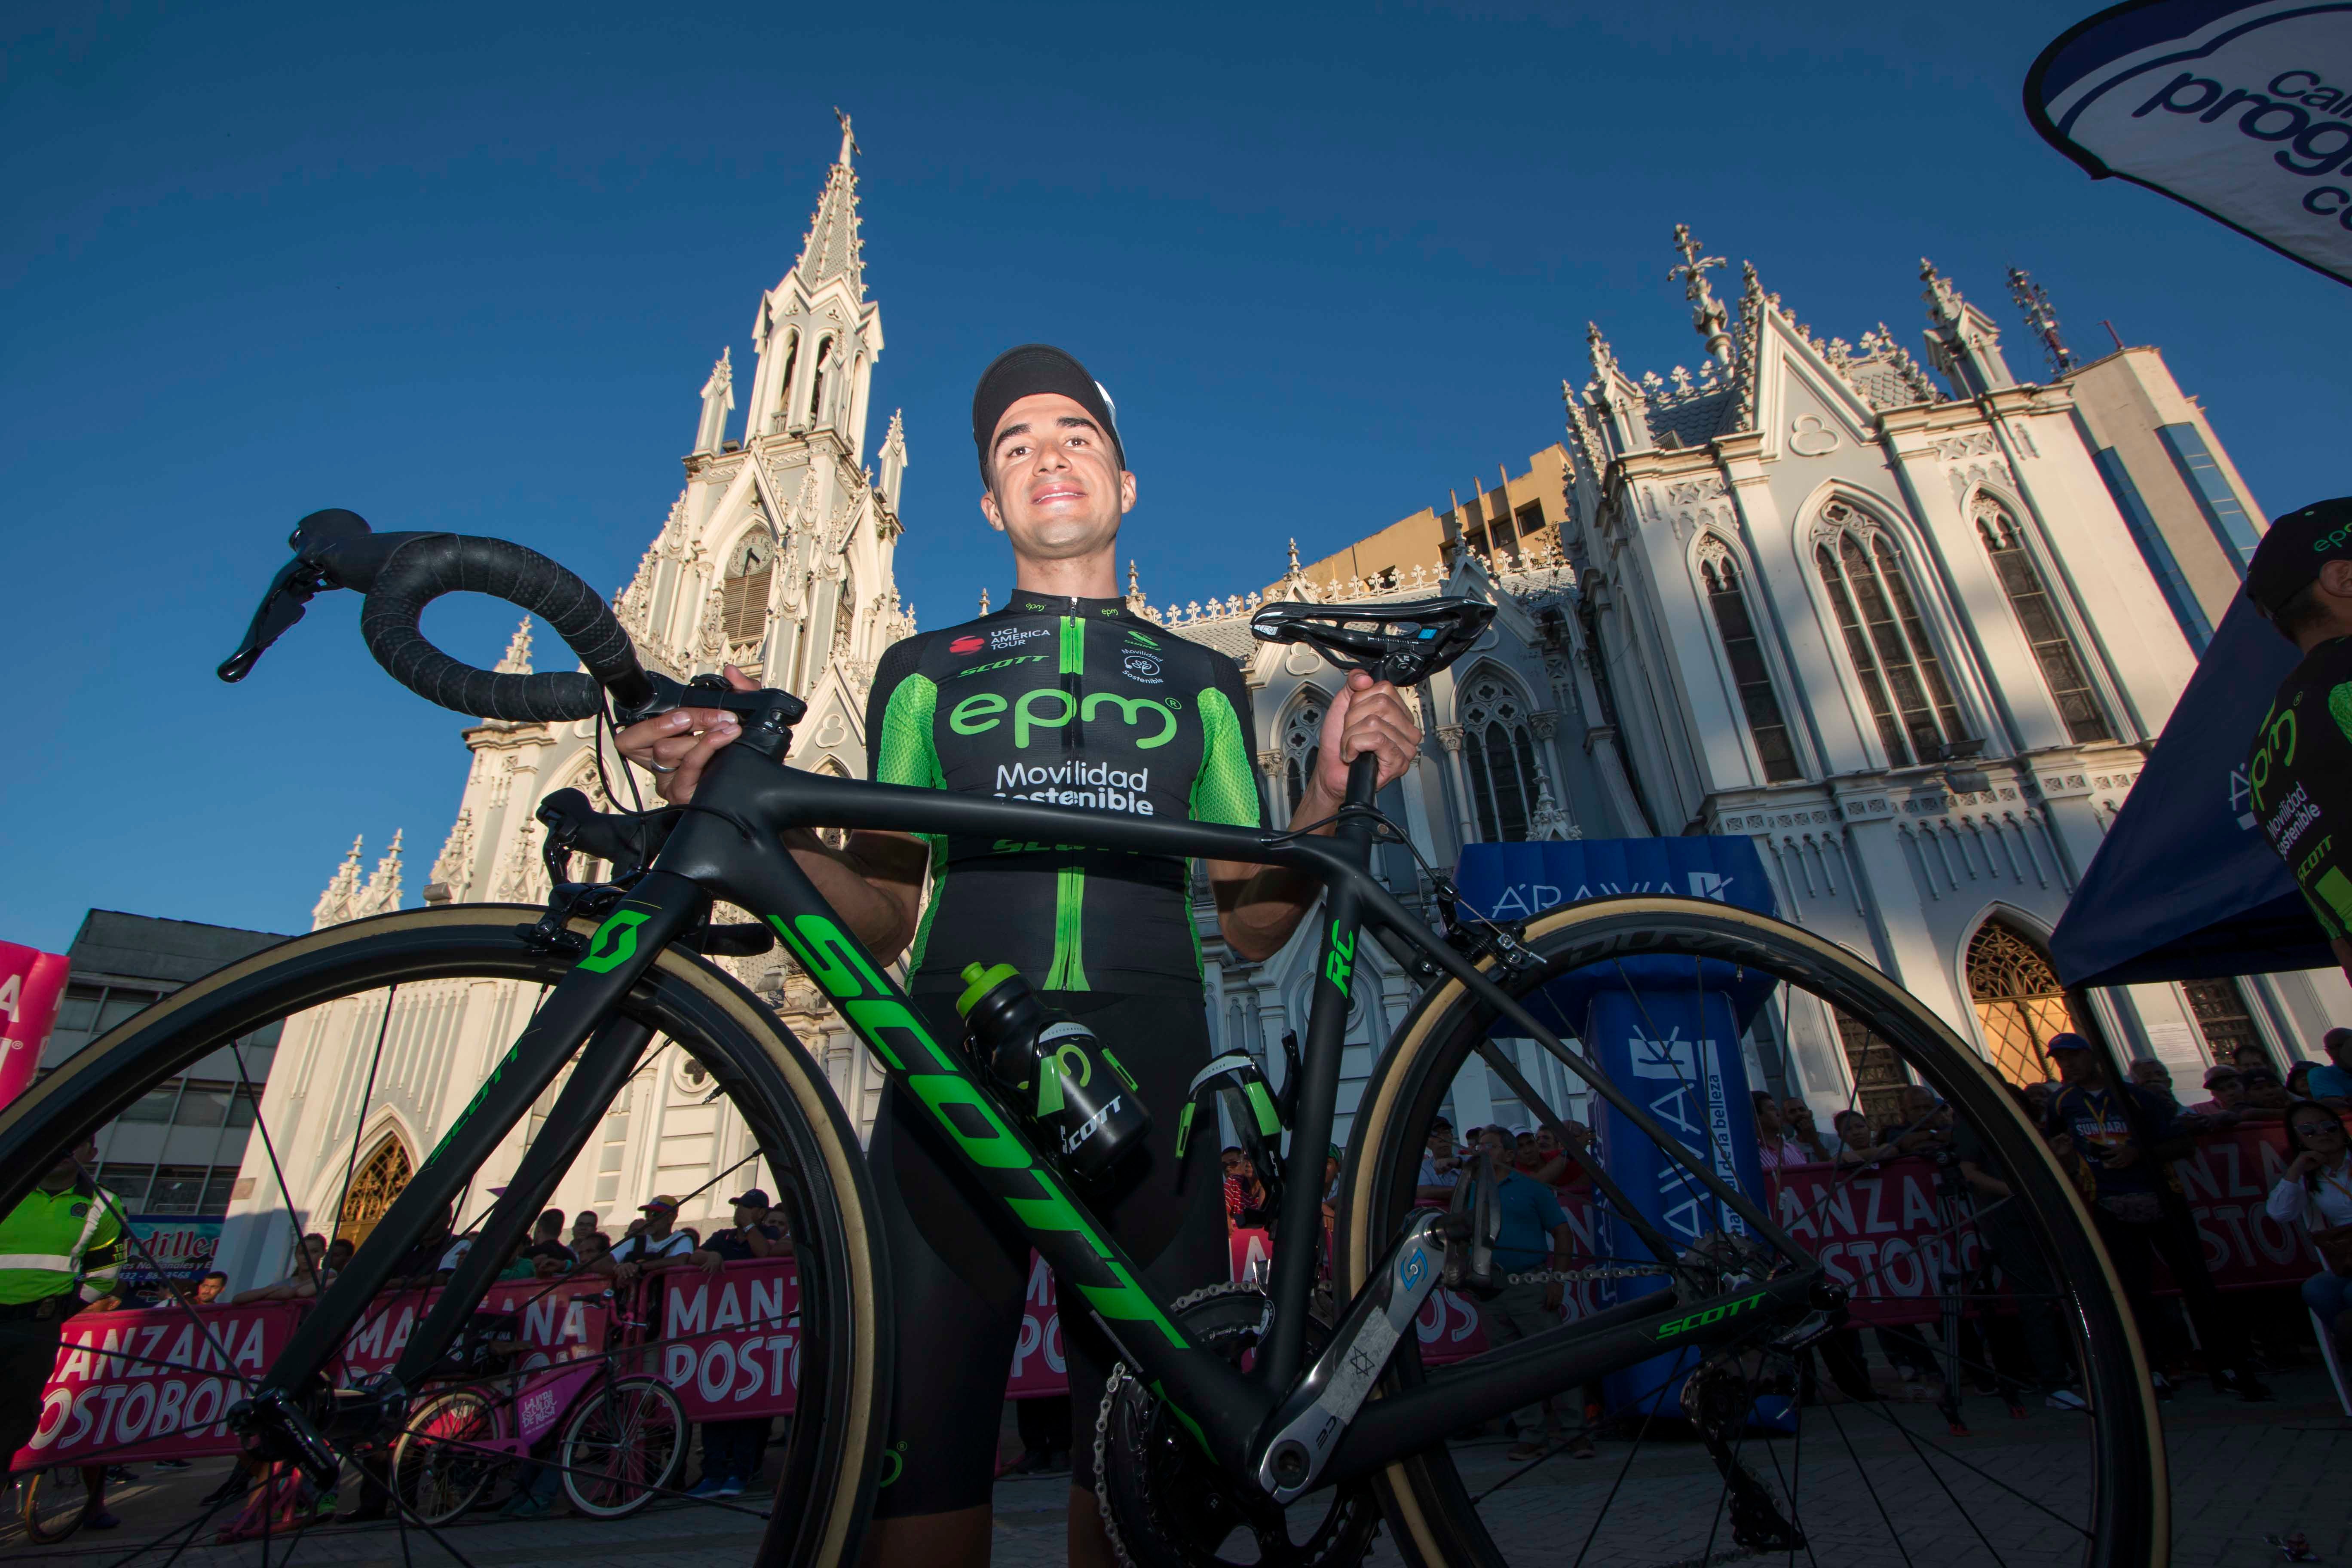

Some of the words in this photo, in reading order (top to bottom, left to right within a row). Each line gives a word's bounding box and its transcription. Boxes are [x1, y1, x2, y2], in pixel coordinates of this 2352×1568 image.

[2131, 72, 2352, 177] prog
[991, 627, 1018, 637] UCI
[991, 629, 1050, 645] AMERICA
[991, 639, 1026, 650] TOUR
[957, 655, 1049, 678] SCOTT
[1121, 648, 1163, 663] Movilidad
[1122, 669, 1164, 684] Sostenible
[996, 760, 1148, 793] Movilidad
[993, 787, 1154, 816] stenible
[2266, 780, 2308, 843] Movilidad
[1709, 1074, 1727, 1128] belleza
[766, 914, 1191, 1349] SCOTT
[1656, 1291, 1768, 1341] SCOTT
